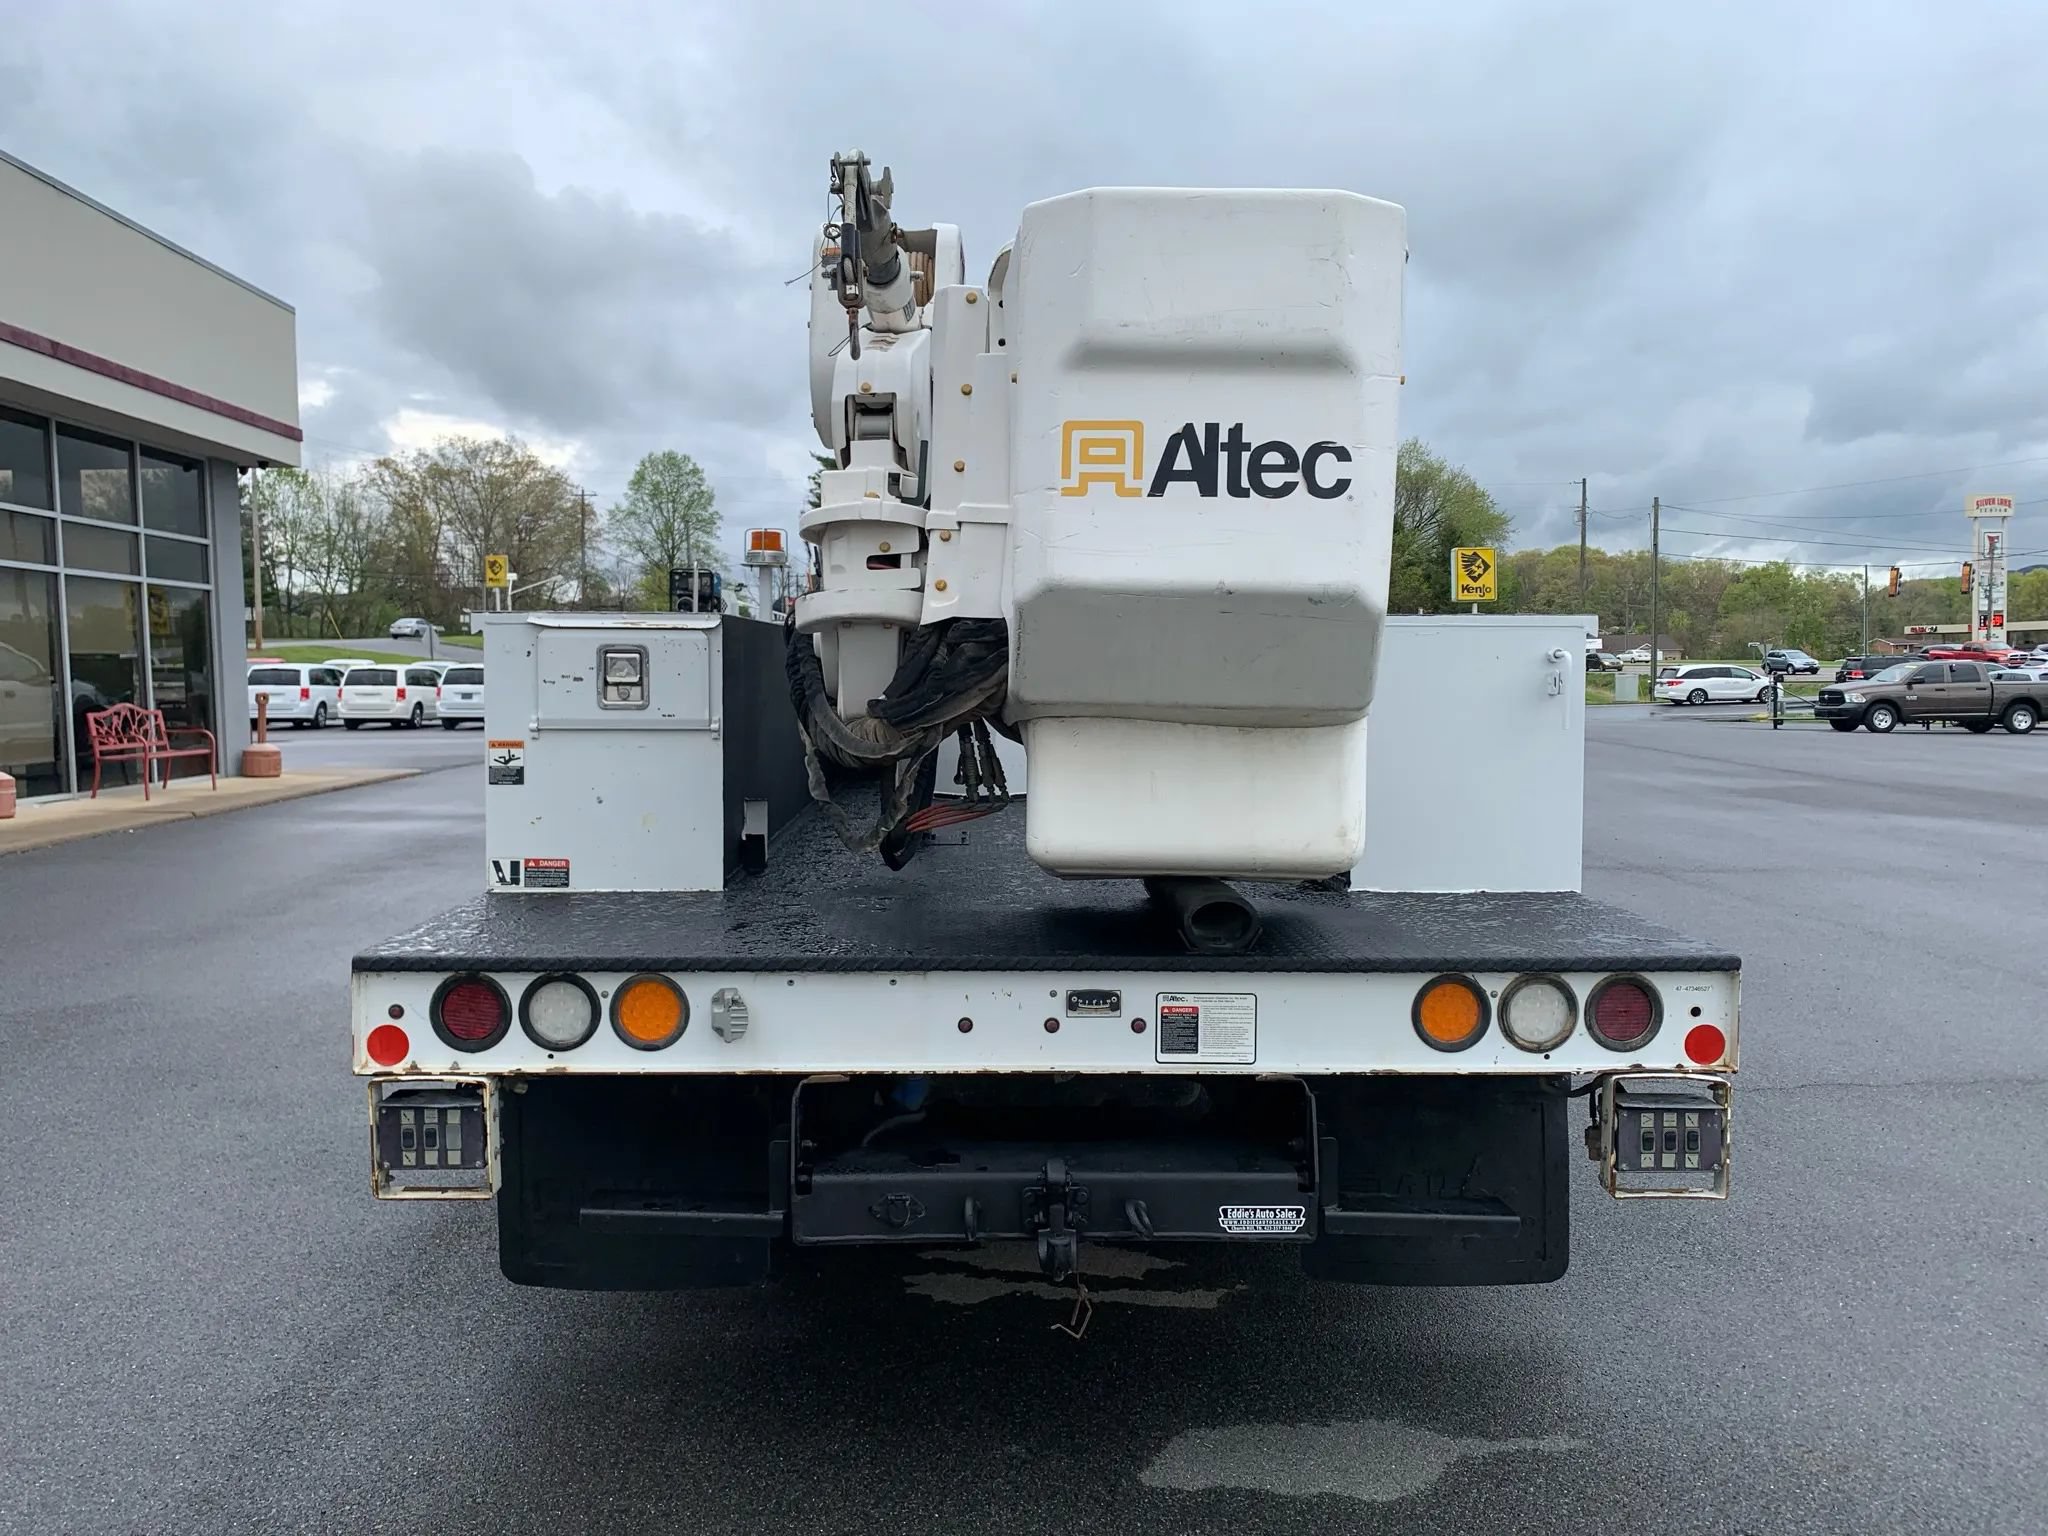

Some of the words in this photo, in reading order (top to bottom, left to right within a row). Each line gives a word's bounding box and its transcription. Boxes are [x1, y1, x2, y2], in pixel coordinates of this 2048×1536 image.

[1147, 422, 1352, 499] Altec
[1461, 584, 1492, 598] Kenjo
[1227, 1208, 1254, 1219] Eddie's
[1255, 1208, 1275, 1219] Auto
[1276, 1208, 1297, 1219] Sales
